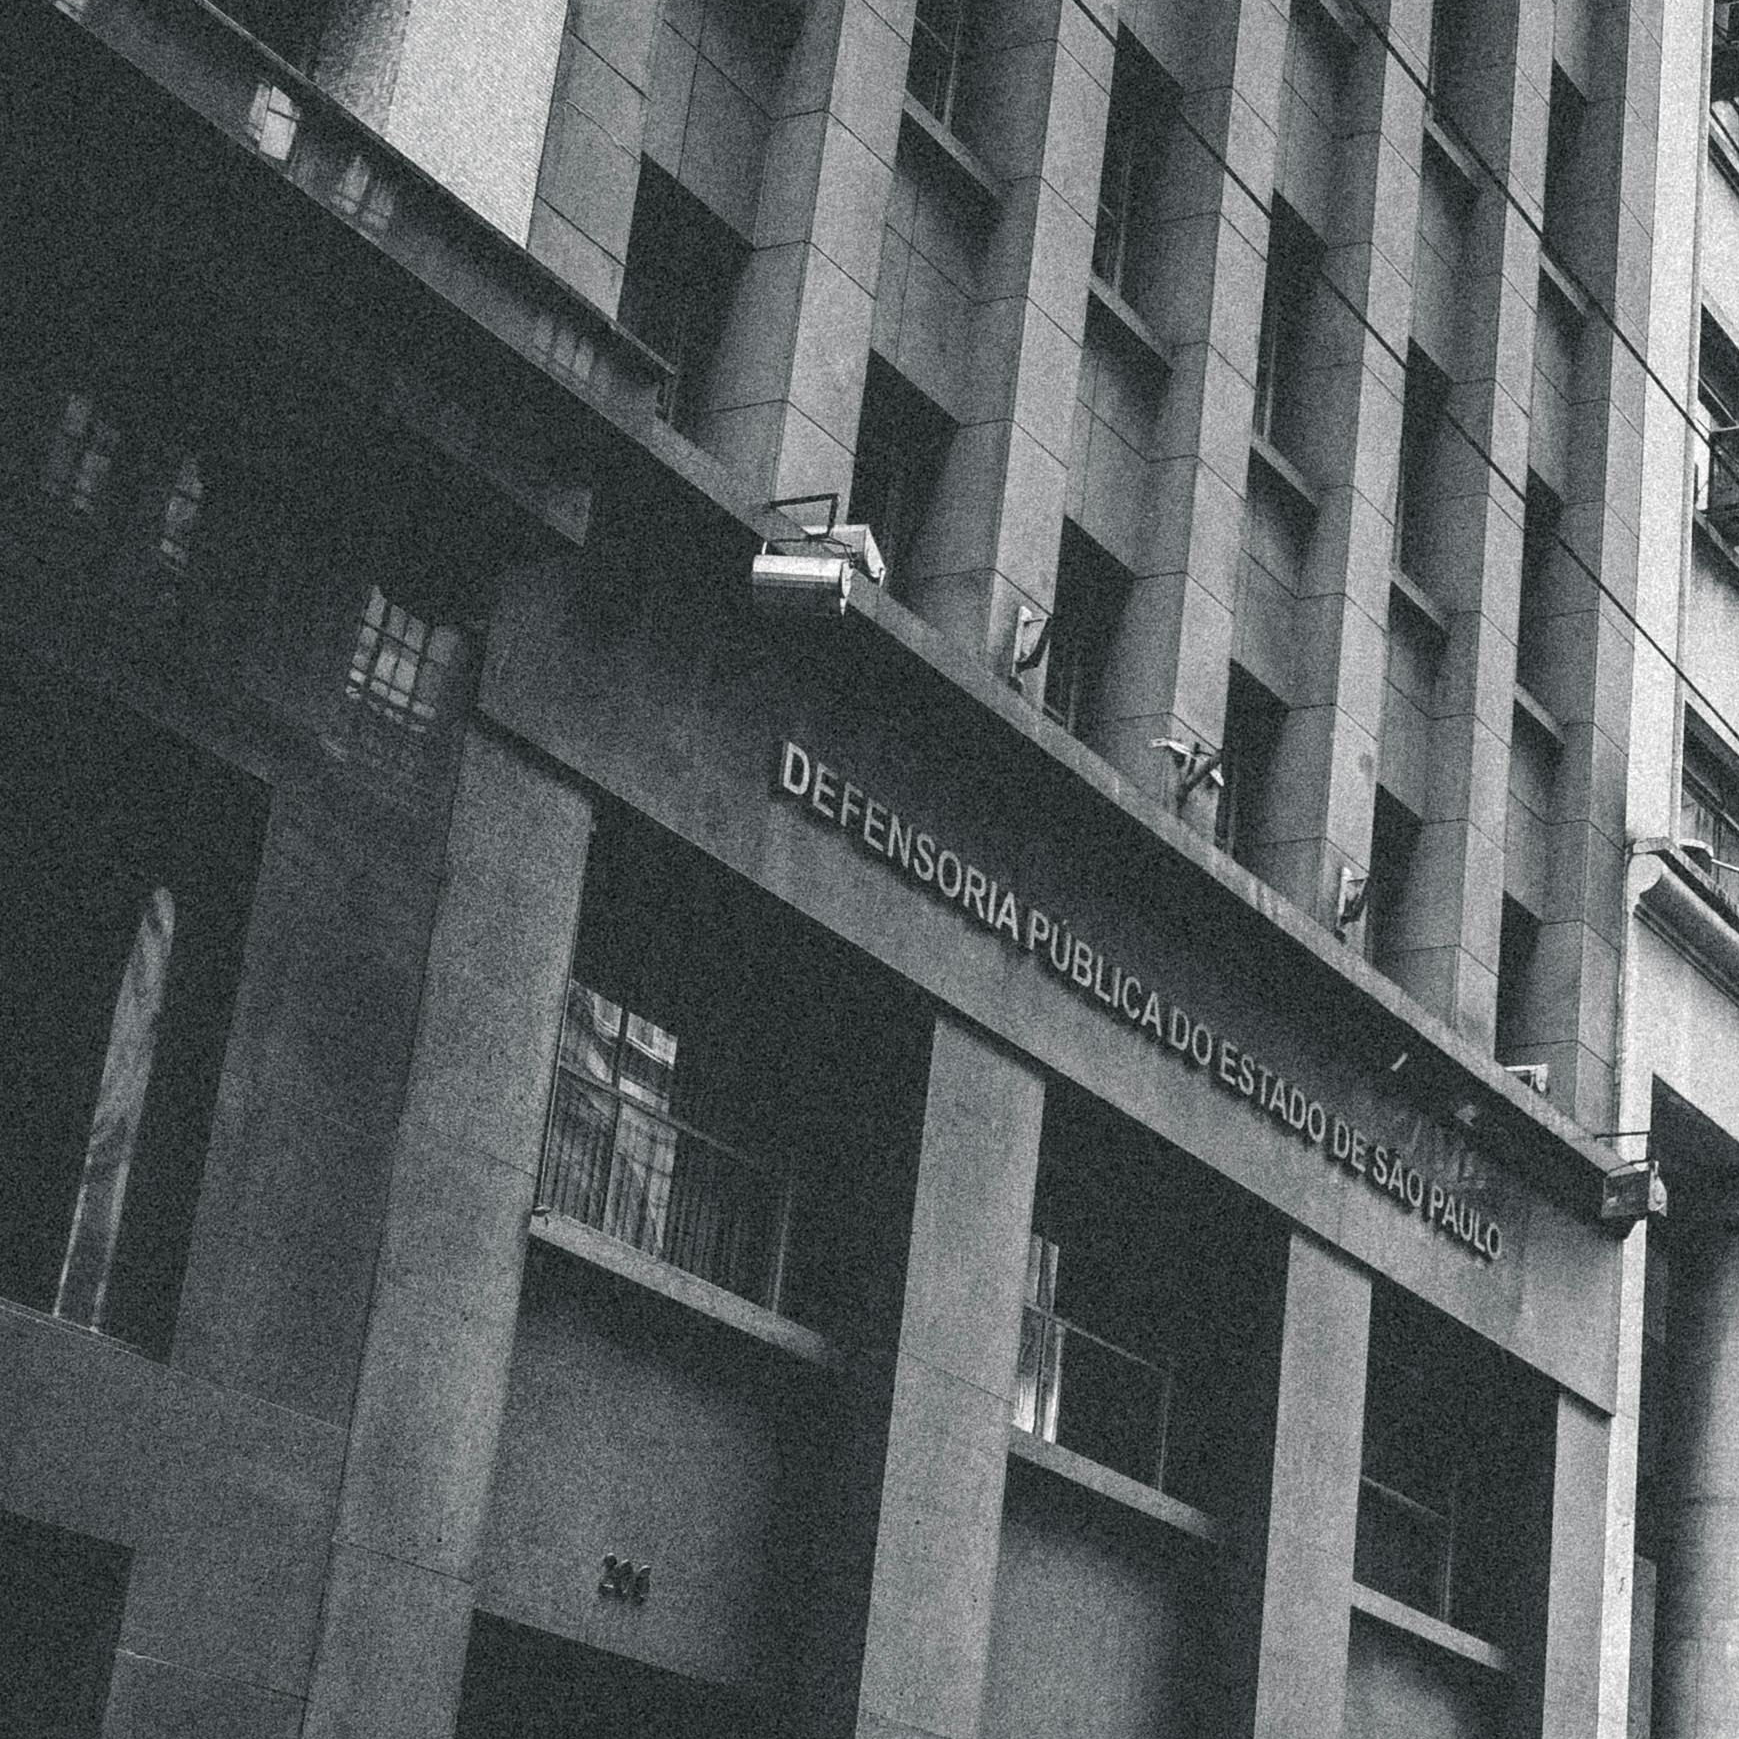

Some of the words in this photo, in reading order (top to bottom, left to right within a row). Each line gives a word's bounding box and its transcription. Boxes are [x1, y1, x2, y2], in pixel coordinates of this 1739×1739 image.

[783, 741, 1020, 941] DEFENSORIA
[1027, 909, 1163, 1037] PÚBLICA
[1169, 1006, 1213, 1065] DO
[1218, 1040, 1327, 1142] ESTADO
[1332, 1116, 1366, 1174] DE
[1430, 1185, 1502, 1260] PAULO
